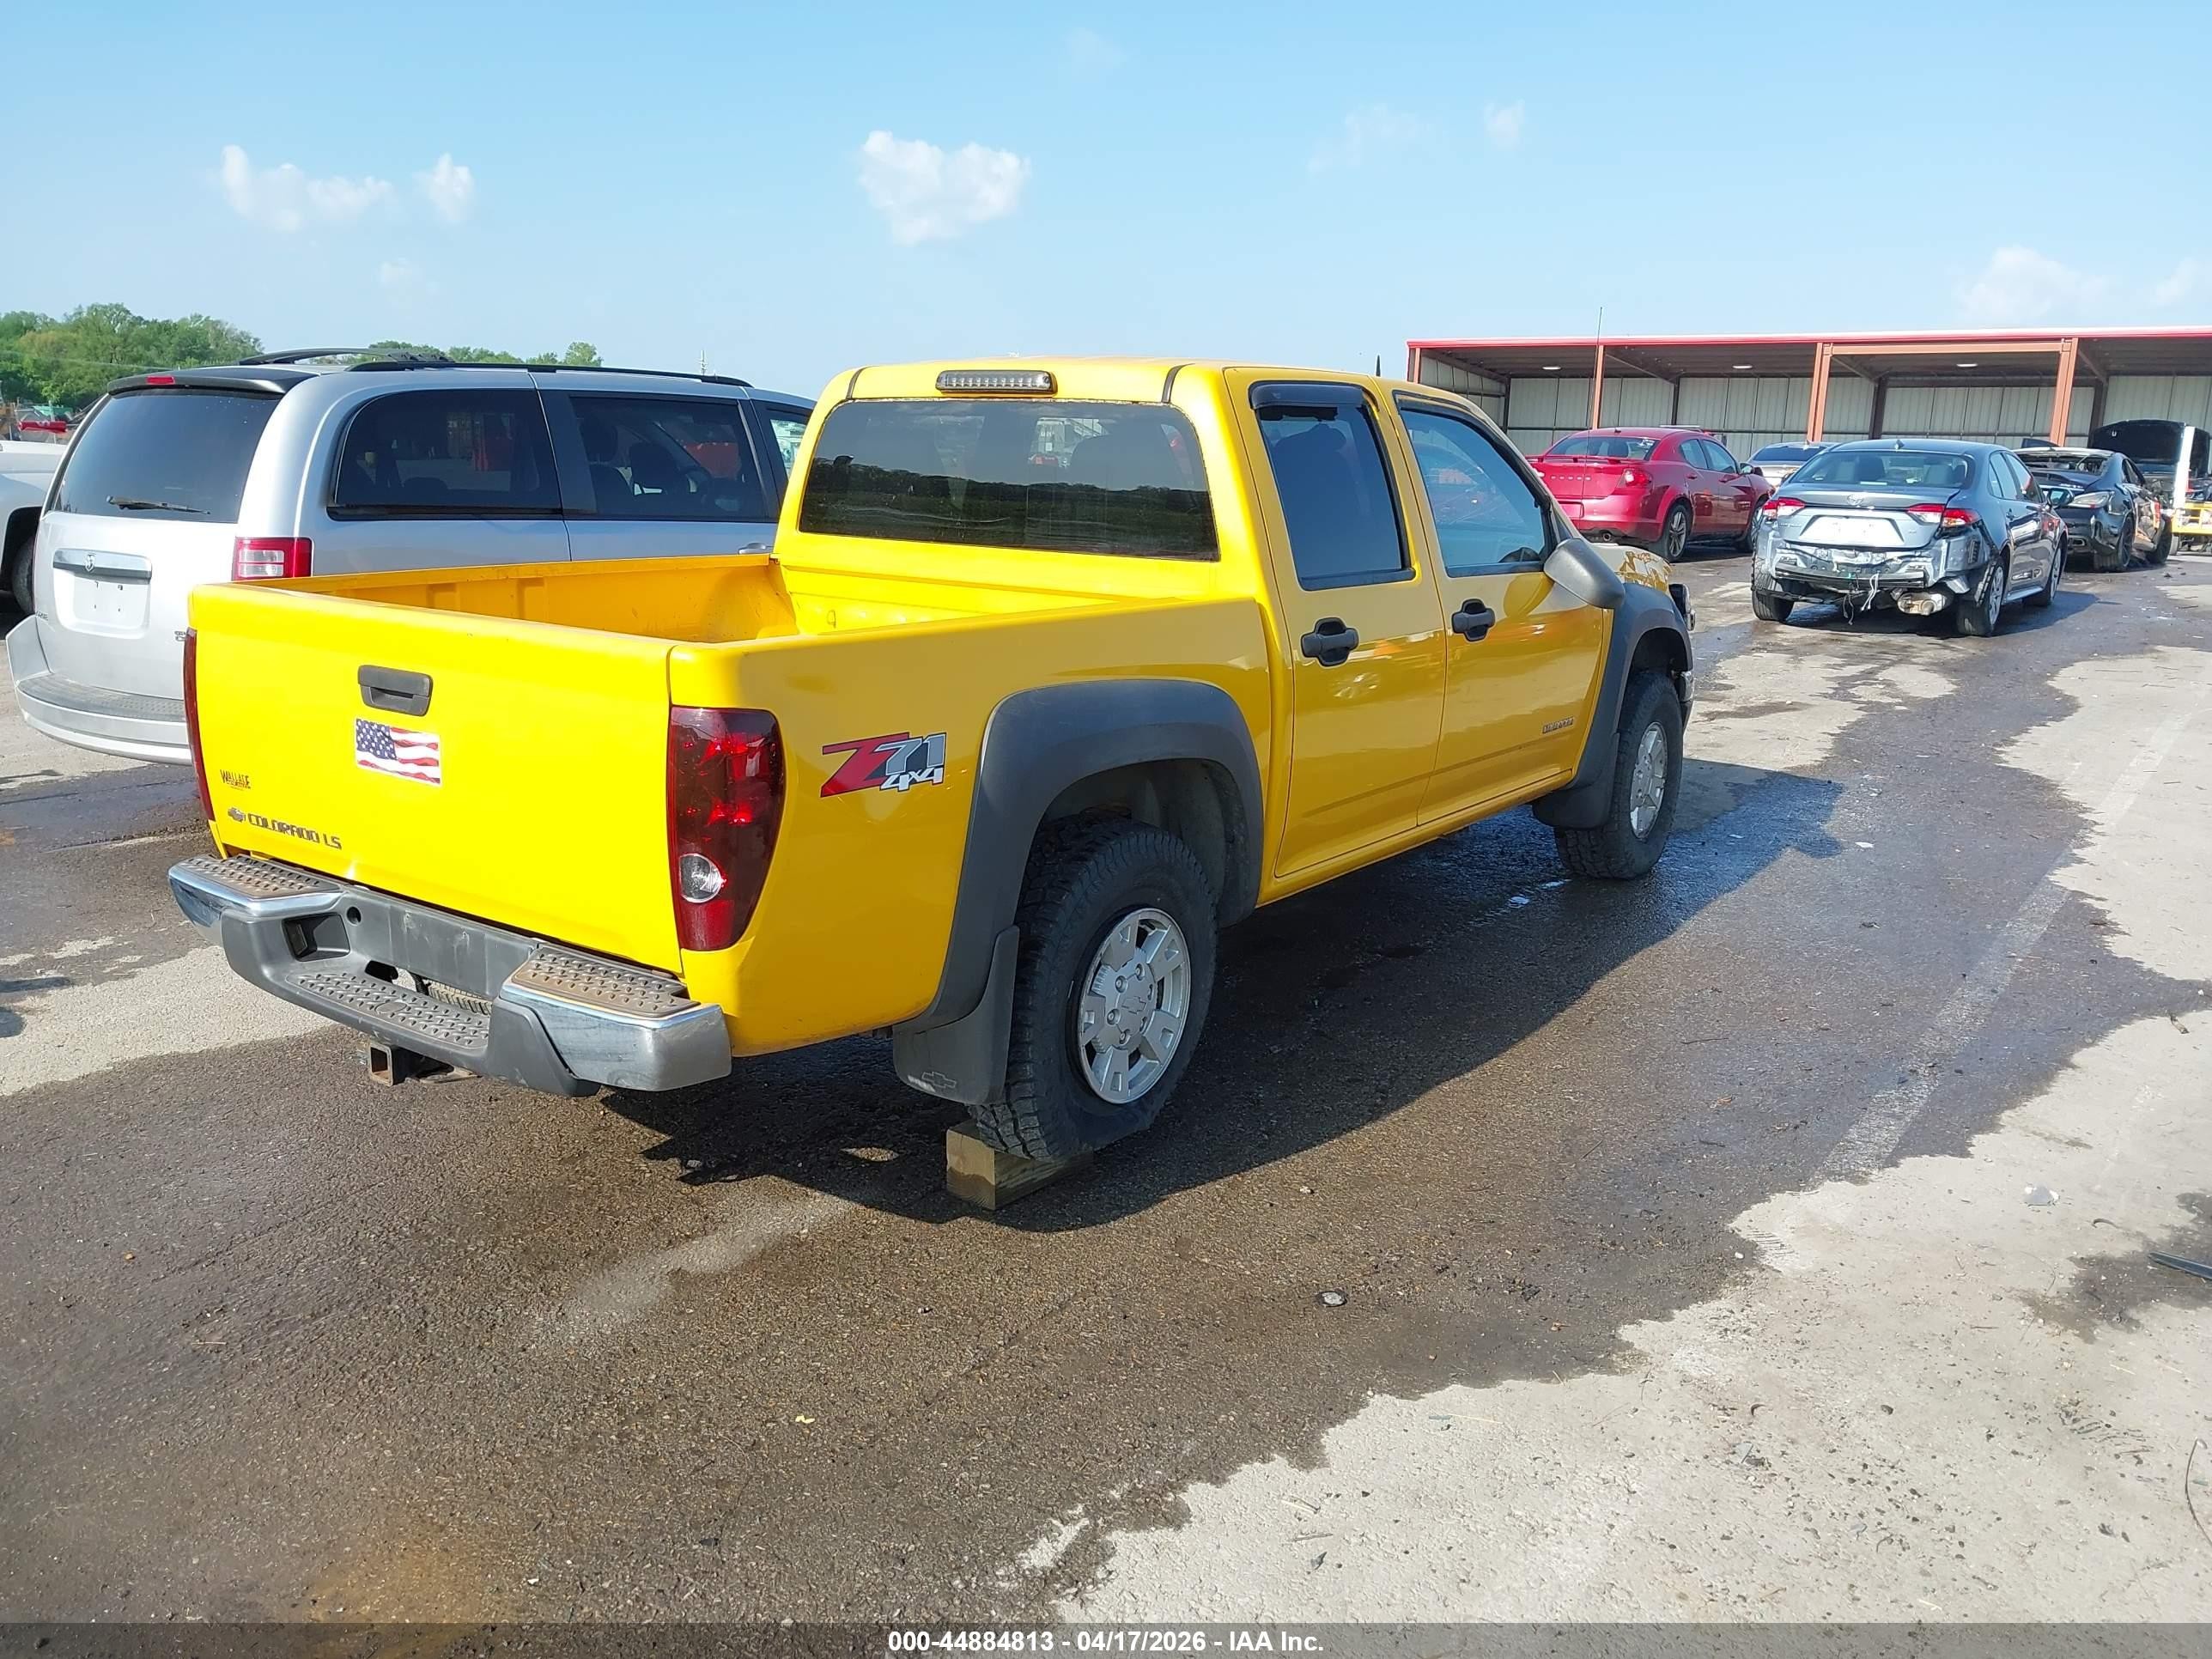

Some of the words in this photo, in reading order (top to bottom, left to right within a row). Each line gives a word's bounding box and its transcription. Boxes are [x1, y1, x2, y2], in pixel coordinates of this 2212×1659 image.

[820, 732, 946, 797] Z71
[248, 813, 319, 843] COLORADO
[323, 833, 342, 849] LS
